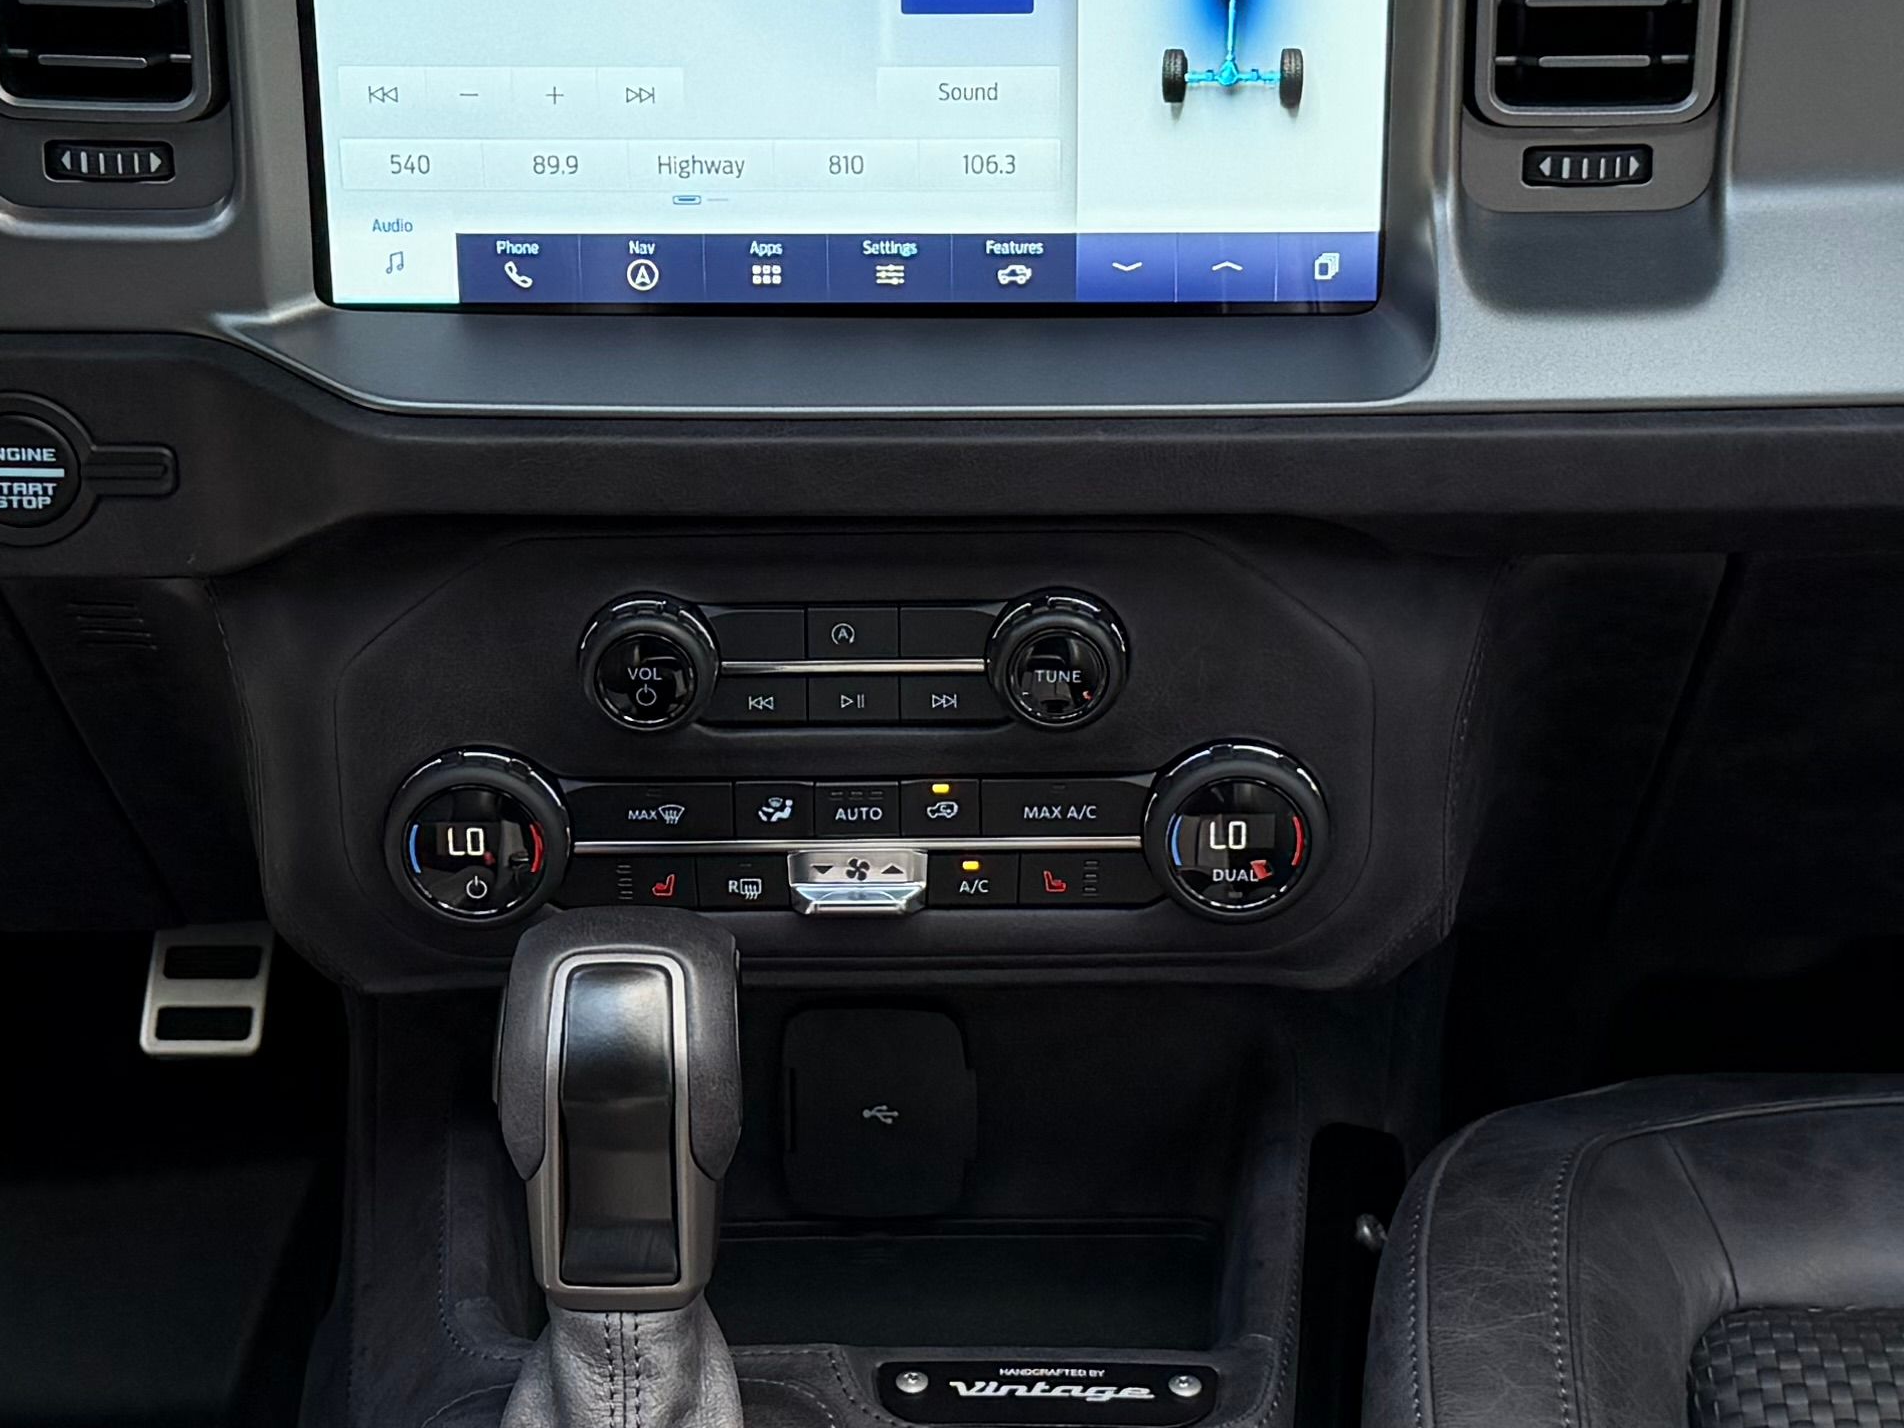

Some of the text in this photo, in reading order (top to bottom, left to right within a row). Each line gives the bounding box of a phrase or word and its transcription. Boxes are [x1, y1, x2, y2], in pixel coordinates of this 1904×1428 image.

[938, 82, 999, 102] Sound
[390, 154, 430, 175] 540
[533, 154, 579, 175] 89.9
[657, 155, 745, 179] Highway
[829, 154, 864, 175] 810
[963, 154, 1016, 175] 106.3
[372, 218, 413, 233] Audio
[496, 240, 540, 255] Phone
[629, 240, 656, 255] Nav
[749, 240, 783, 256] Apps
[862, 240, 918, 257] Settings
[986, 240, 1044, 255] Features
[627, 667, 663, 681] VOL
[1034, 669, 1082, 683] TUNE
[627, 809, 658, 820] MAX
[835, 807, 883, 821] AUTO
[1023, 804, 1097, 820] MAX A/C
[447, 827, 485, 856] LO
[1209, 821, 1247, 850] LO
[1212, 868, 1259, 882] DUAL
[958, 879, 989, 893] A/C
[999, 1368, 1106, 1378] HANDCRAFTED BY
[949, 1379, 1156, 1402] Vintage
